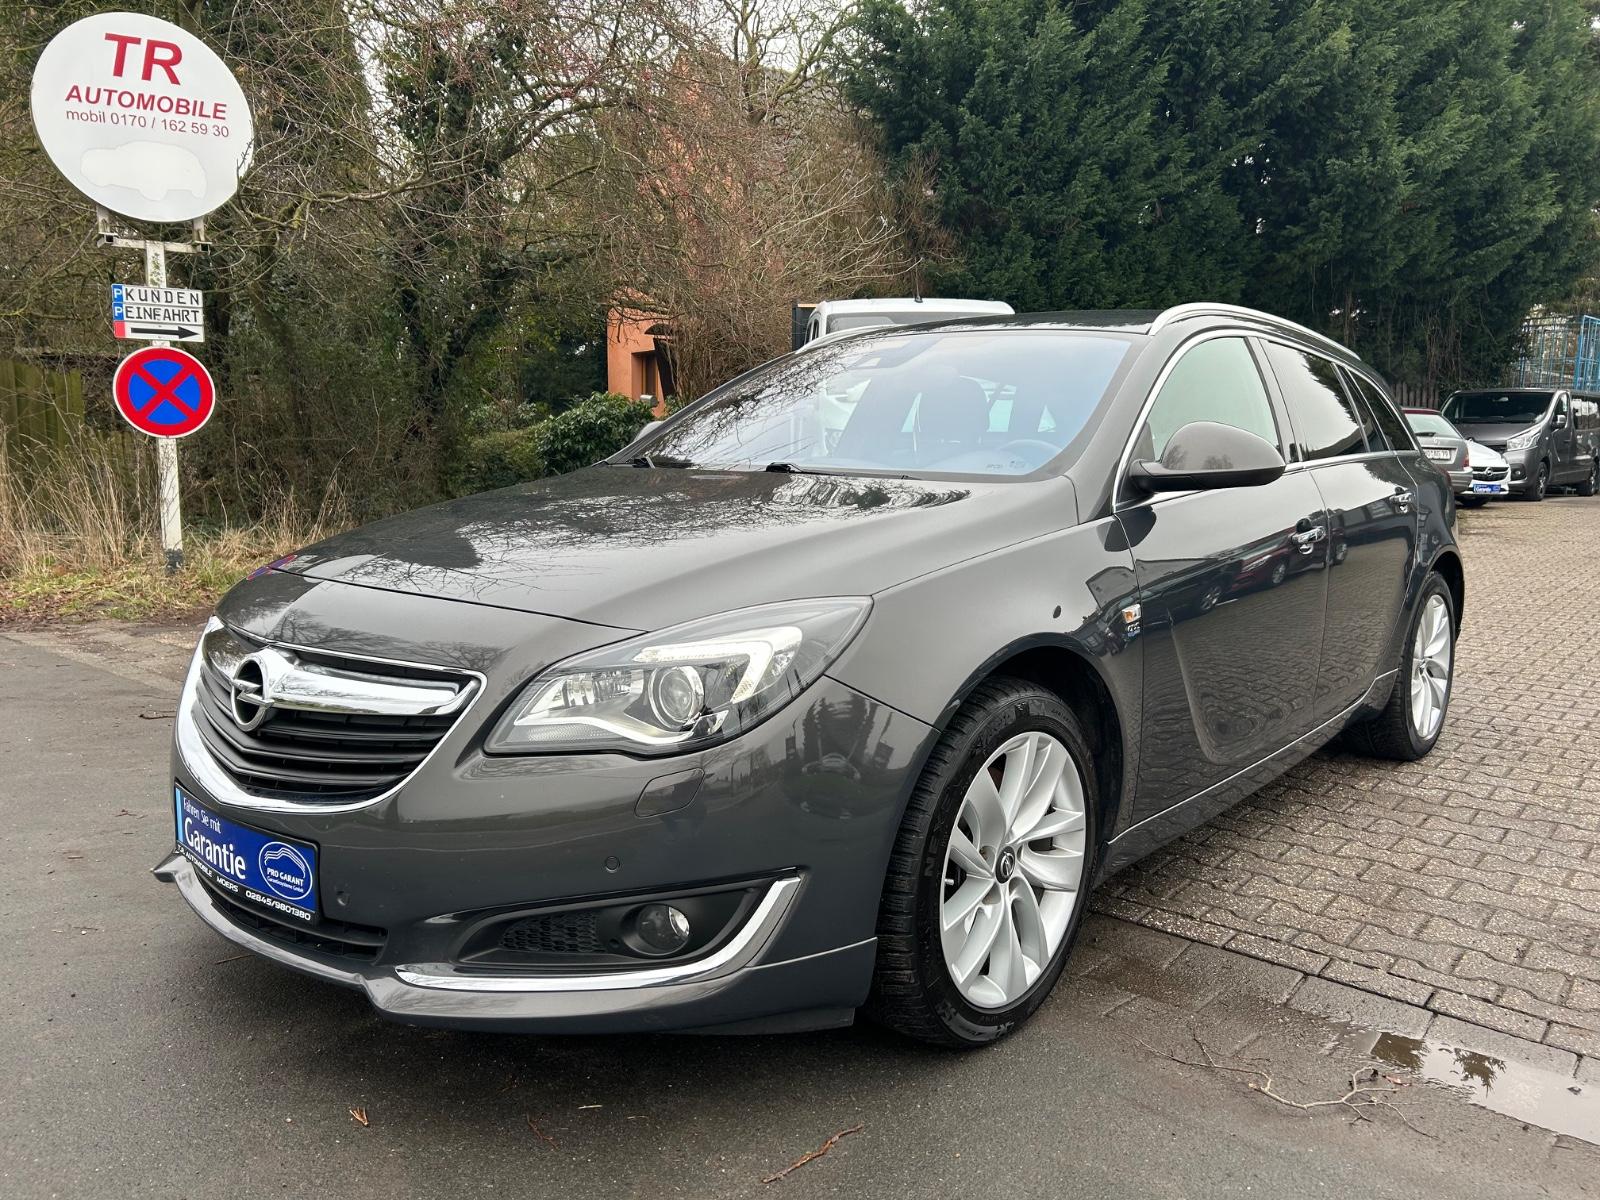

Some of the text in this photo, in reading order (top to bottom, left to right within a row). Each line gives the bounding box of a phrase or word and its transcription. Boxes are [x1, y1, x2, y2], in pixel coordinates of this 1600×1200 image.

[105, 33, 183, 86] TR
[65, 85, 227, 120] AUTOMOBILE
[66, 109, 106, 124] mobil
[111, 112, 147, 128] 0170
[160, 119, 187, 133] 162
[191, 123, 208, 135] 59
[212, 125, 230, 138] 30
[113, 287, 199, 306] P KUNDEN
[115, 306, 123, 317] P
[183, 796, 222, 834] Fahren Sie mit
[184, 816, 246, 880] Garantie
[216, 875, 239, 893] MOERS
[266, 867, 304, 887] PRO GARANT
